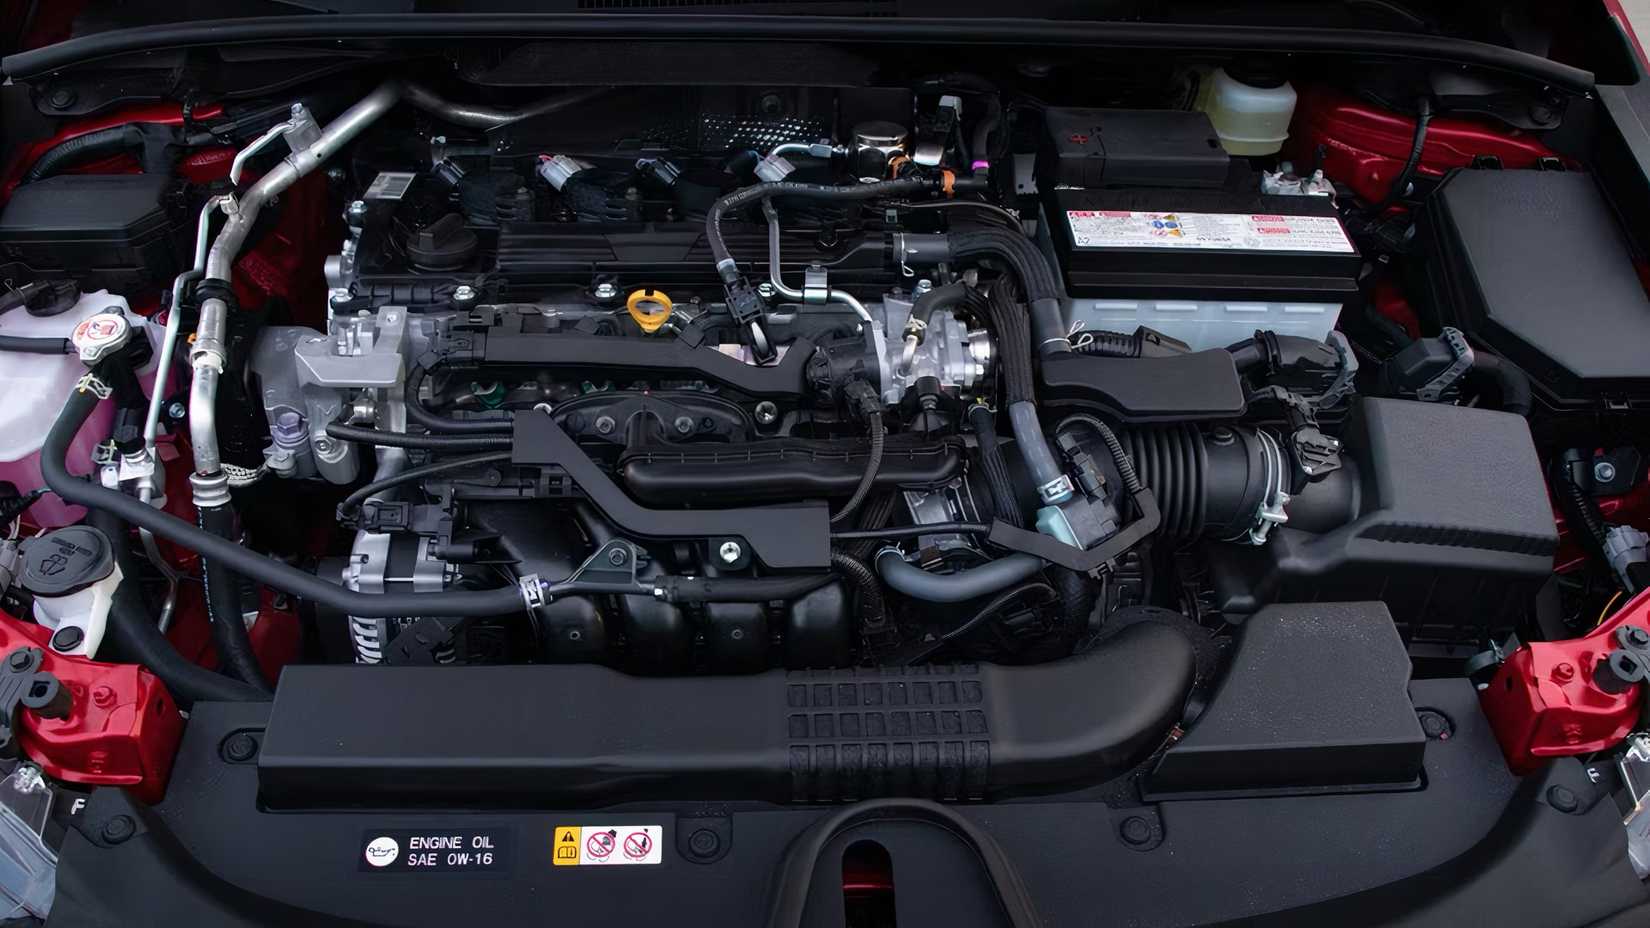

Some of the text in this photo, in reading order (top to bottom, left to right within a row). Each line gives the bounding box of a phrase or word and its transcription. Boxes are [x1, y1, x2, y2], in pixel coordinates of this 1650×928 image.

[71, 798, 86, 815] F
[410, 836, 495, 850] ENGINE OIL
[408, 853, 493, 866] SAE 0W-16
